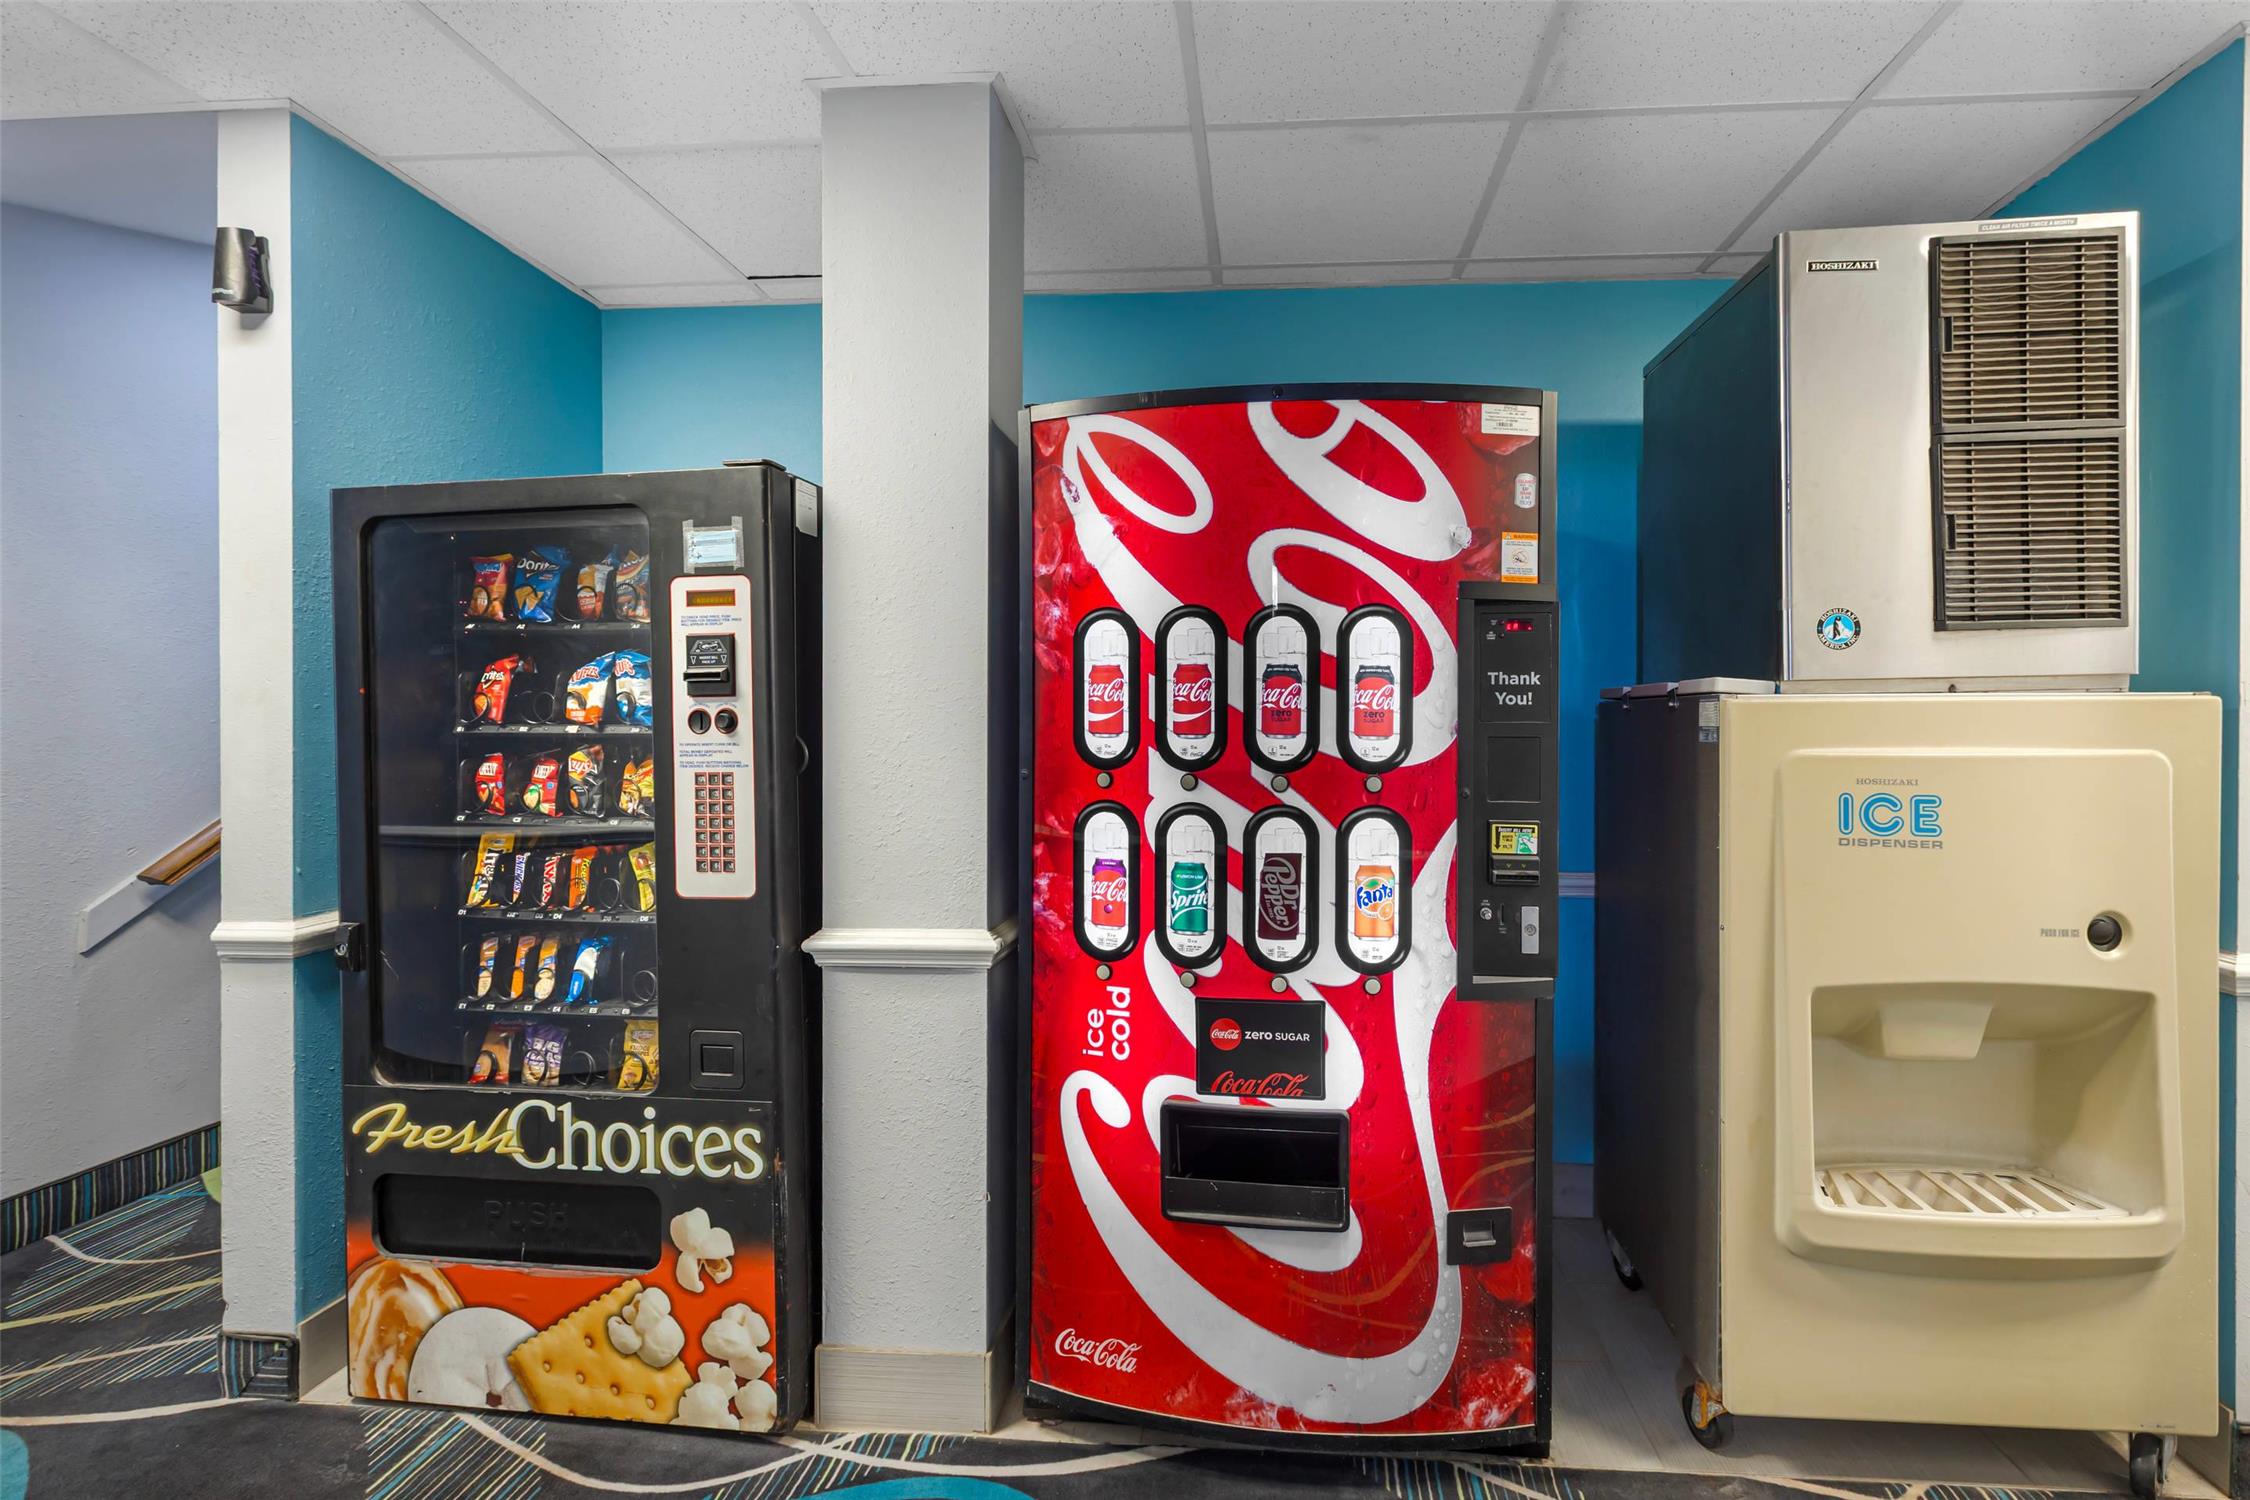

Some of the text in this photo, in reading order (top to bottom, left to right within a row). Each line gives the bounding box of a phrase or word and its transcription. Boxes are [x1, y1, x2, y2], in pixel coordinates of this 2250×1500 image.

[1811, 261, 1875, 271] HOSHIZAKI
[1488, 672, 1541, 686] Thank
[1495, 692, 1533, 705] You!
[1856, 778, 1918, 787] HOSHIZAKI
[1838, 792, 1943, 837] ICE
[1838, 837, 1943, 849] DISPENSER
[1261, 866, 1290, 926] Pepper
[1082, 1008, 1105, 1057] ice
[1105, 985, 1131, 1061] cold
[1211, 1028, 1310, 1042] Coca-Cola zero SUGAR
[1210, 1070, 1311, 1097] Coca-Cola
[352, 1099, 764, 1180] Fresh Choices
[485, 1200, 568, 1229] PUSH
[1055, 1327, 1142, 1374] Coca-Cola
